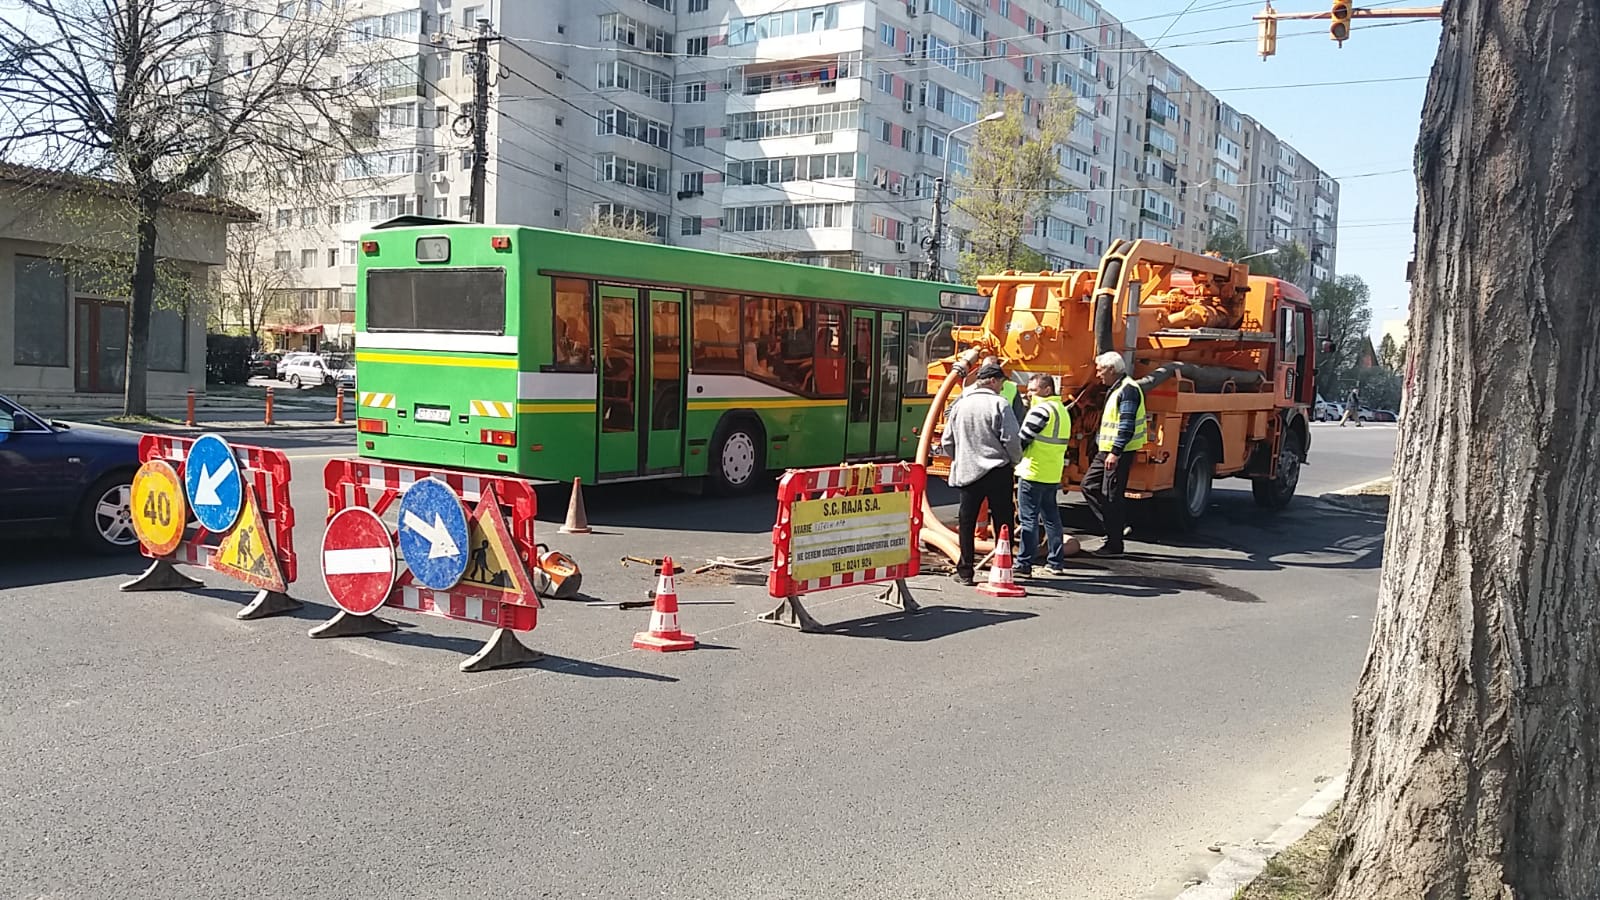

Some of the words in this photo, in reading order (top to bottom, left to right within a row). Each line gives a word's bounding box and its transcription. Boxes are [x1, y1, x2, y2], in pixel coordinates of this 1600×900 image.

[143, 490, 171, 527] 40
[823, 502, 840, 517] S.C.
[841, 500, 863, 515] RAJA
[864, 498, 881, 512] S.A.
[793, 523, 812, 535] AVARIE
[796, 552, 805, 561] NE
[804, 549, 821, 561] CEREM
[837, 544, 856, 555] PENTRU
[831, 562, 846, 573] TEL.:
[846, 559, 860, 570] 0241
[861, 557, 872, 568] 924
